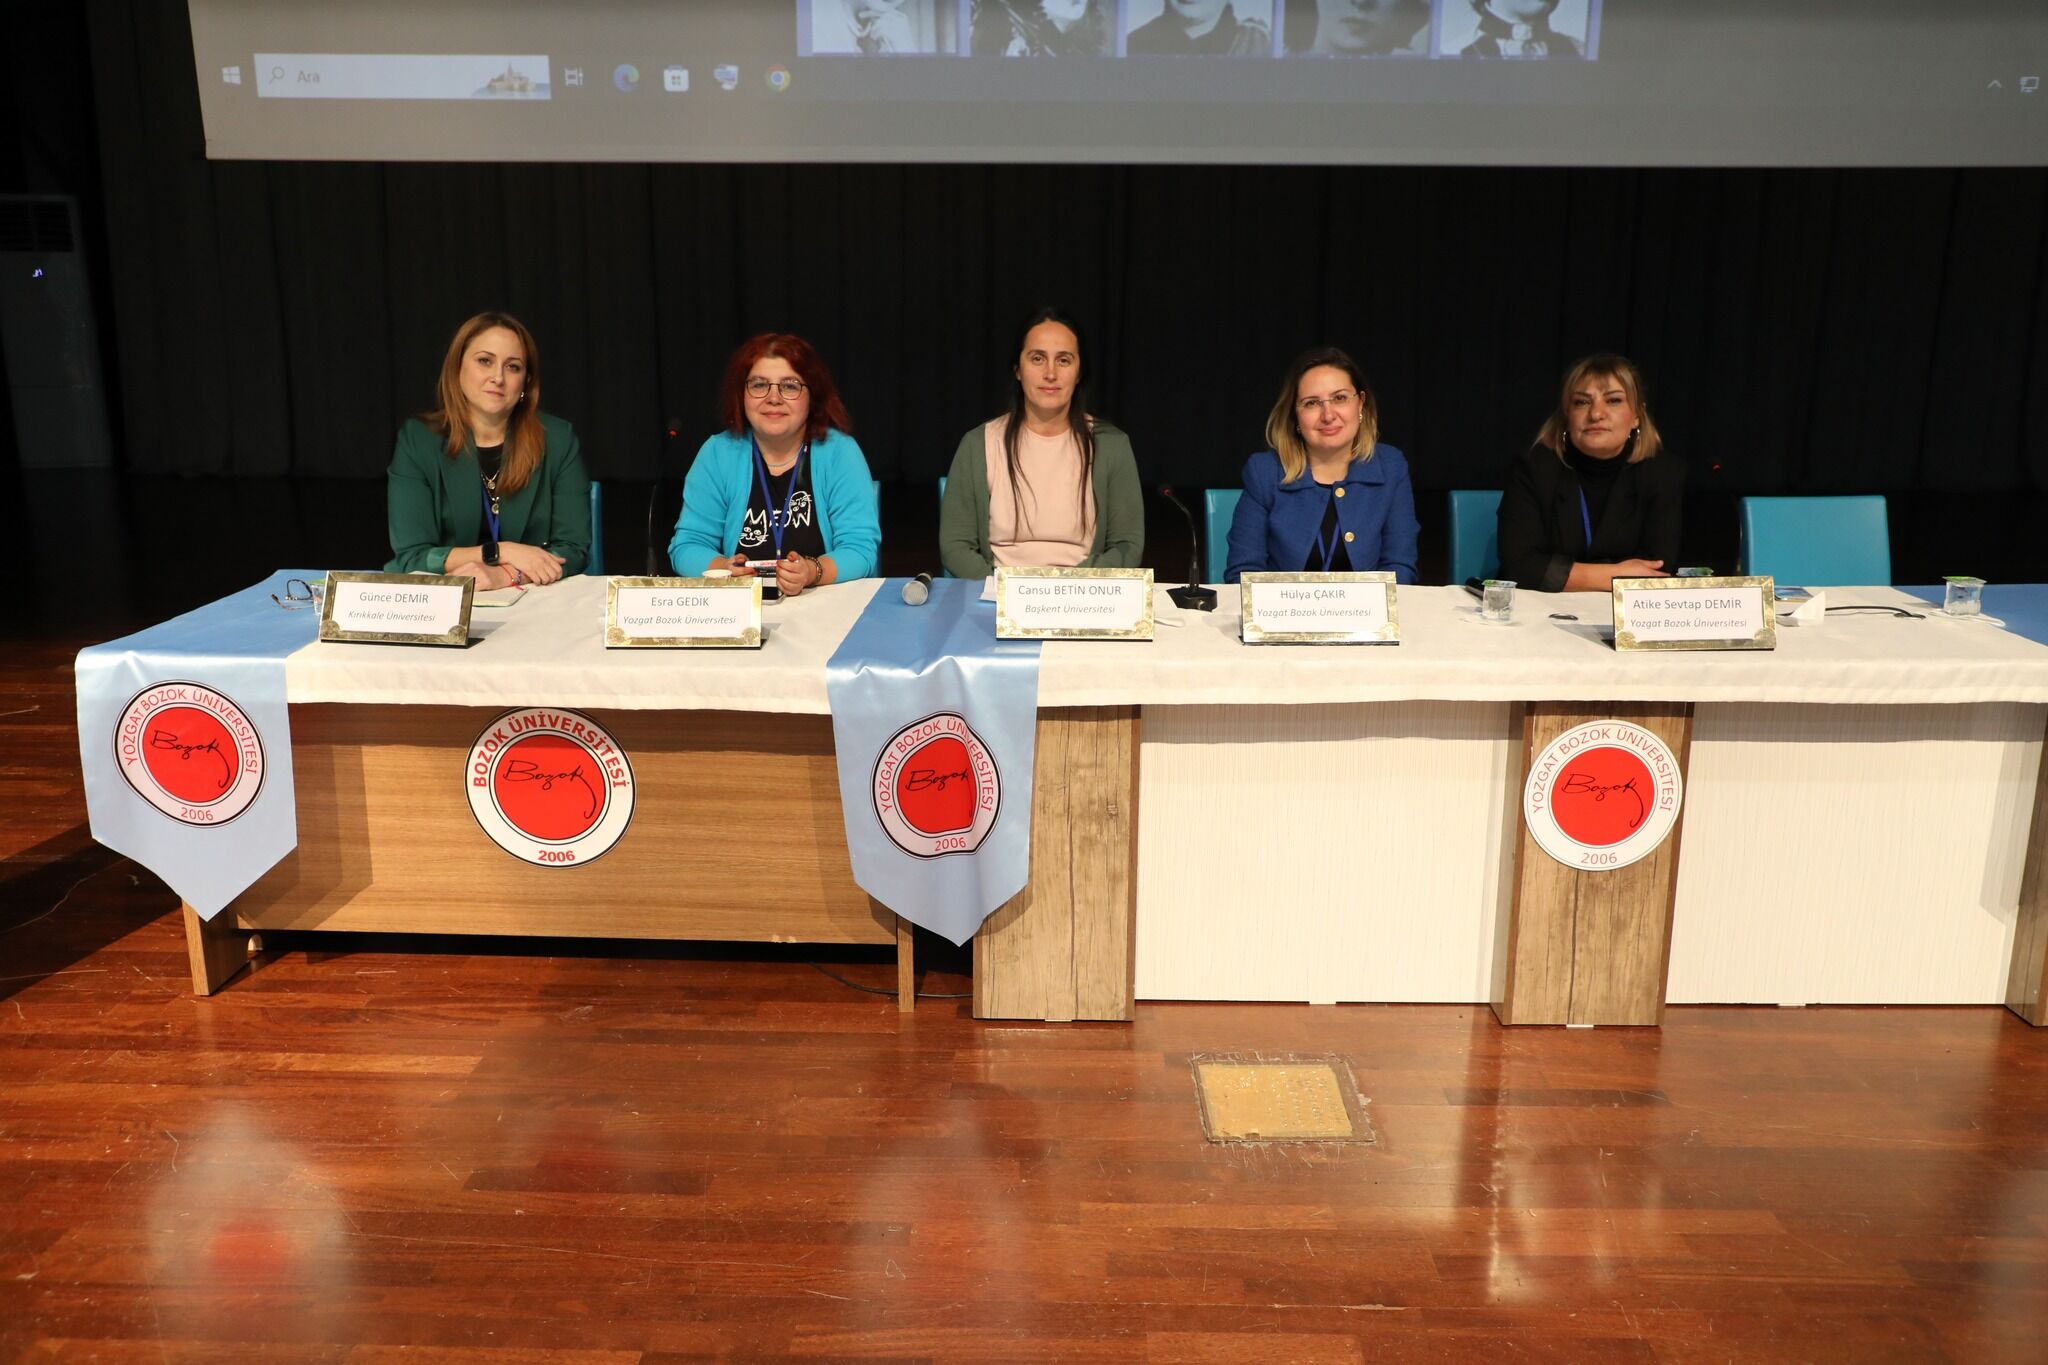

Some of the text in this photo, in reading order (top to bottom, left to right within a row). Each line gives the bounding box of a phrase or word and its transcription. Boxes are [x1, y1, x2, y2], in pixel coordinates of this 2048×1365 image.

[297, 70, 320, 83] Ara
[1018, 583, 1122, 596] Cansu BETİN ONUR
[1280, 589, 1346, 601] Hülya ÇAKIR
[359, 591, 429, 604] Günce DEMİR
[651, 596, 710, 607] Esra GEDİK
[1025, 603, 1115, 615] Başkent Üniversitesi
[1633, 598, 1742, 611] Atike Sevtap DEMİR
[348, 610, 436, 622] Kırıkkale Üniversitesi
[1257, 607, 1371, 618] Yozgat Bozok Üniversitesi
[623, 614, 736, 626] Yozgat Bozok Üniversitesi
[1630, 617, 1747, 630] Yozgat Bozok Üniversitesi
[123, 708, 145, 766] YOZGAT
[141, 688, 187, 711] BOZOK
[473, 711, 630, 788] BOZOK ÜNİVERSİTESİ
[151, 729, 231, 789] Bozok
[879, 751, 899, 813] YOZGAT
[895, 719, 942, 754] BOZOK
[1532, 752, 1559, 813] YOZGAT
[1559, 728, 1611, 755] BOZOK
[503, 760, 597, 820] Bozok
[1561, 773, 1644, 828] Bozok
[181, 807, 214, 821] 2006
[934, 837, 966, 851] 2006
[538, 850, 576, 863] 2006
[1581, 852, 1618, 864] 2006
